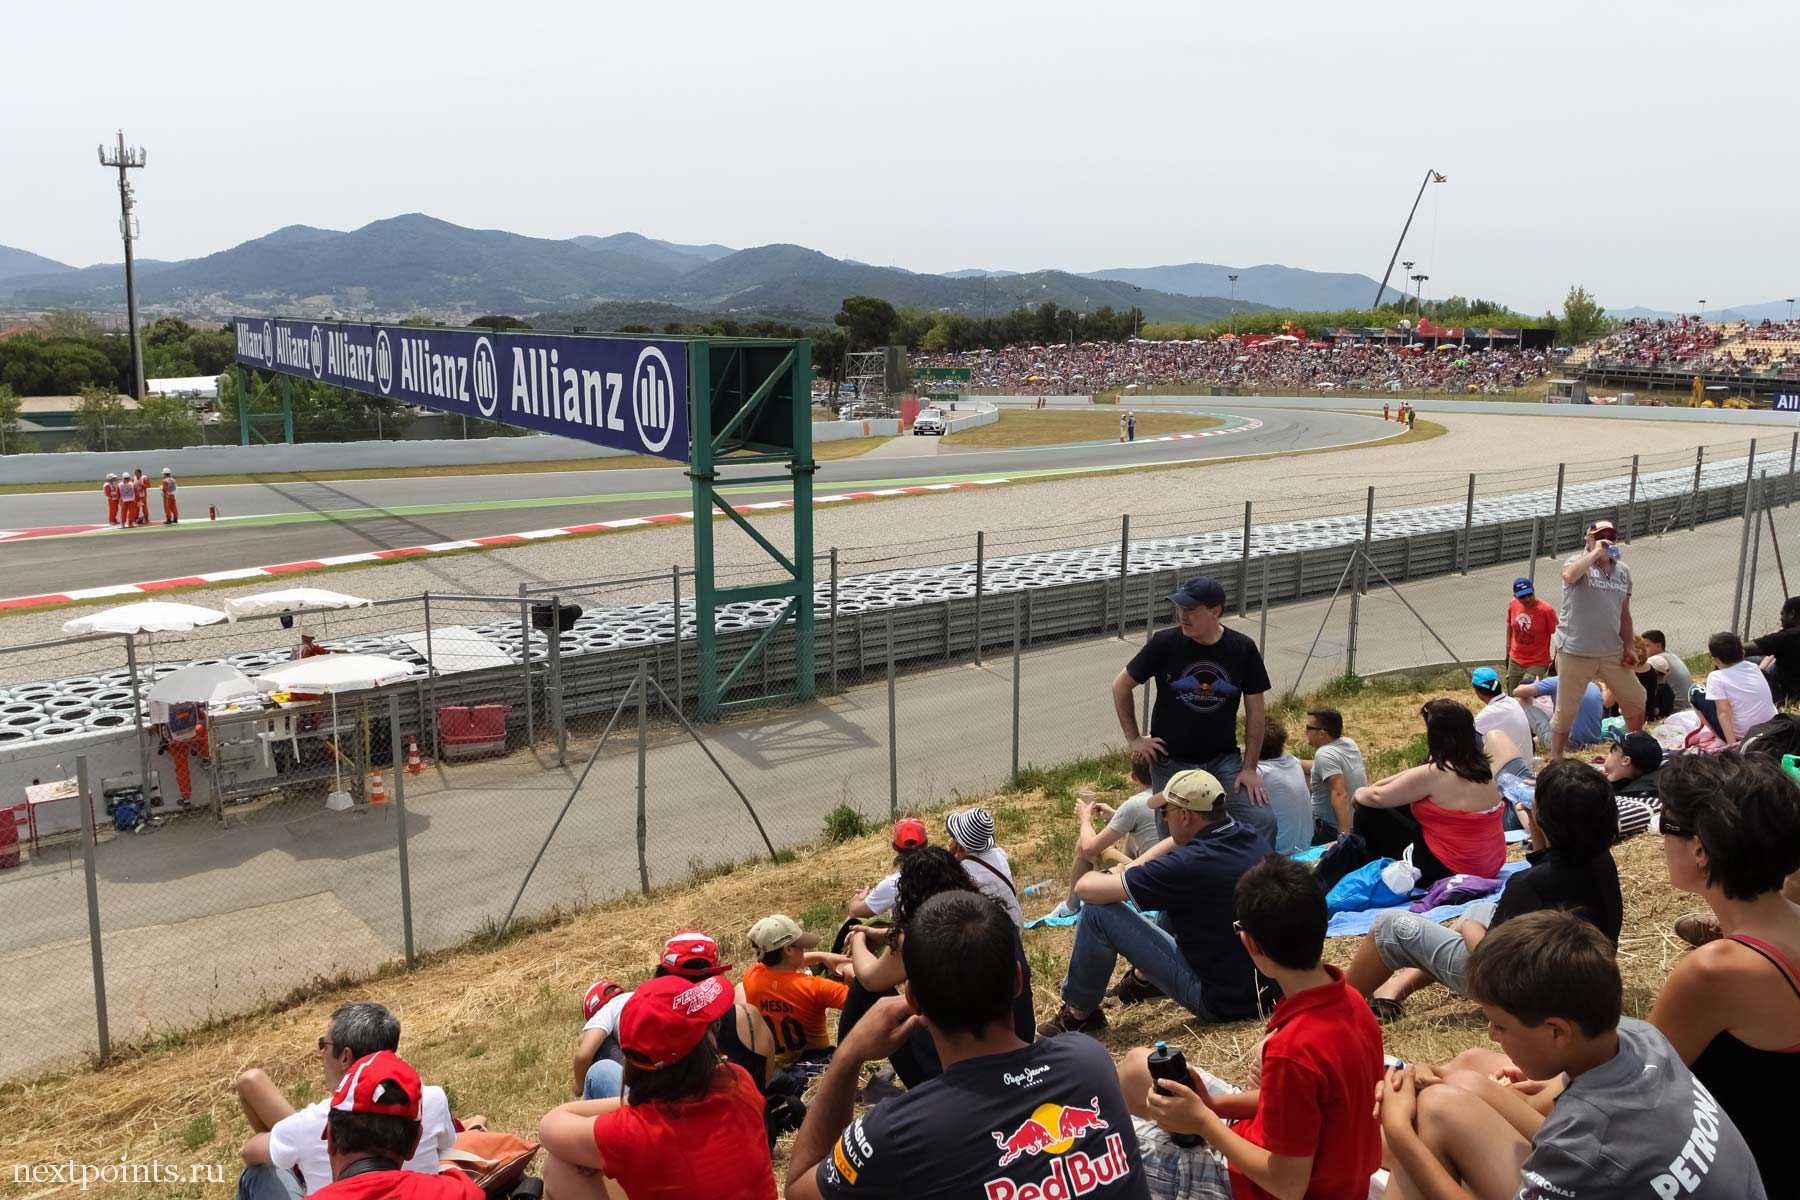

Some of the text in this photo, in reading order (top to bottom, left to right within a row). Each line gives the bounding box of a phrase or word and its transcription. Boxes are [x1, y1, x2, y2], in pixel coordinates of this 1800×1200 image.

[237, 322, 625, 432] Allianz Allianz Allianz Allianz Allianz
[1065, 1132, 1130, 1197] Bull
